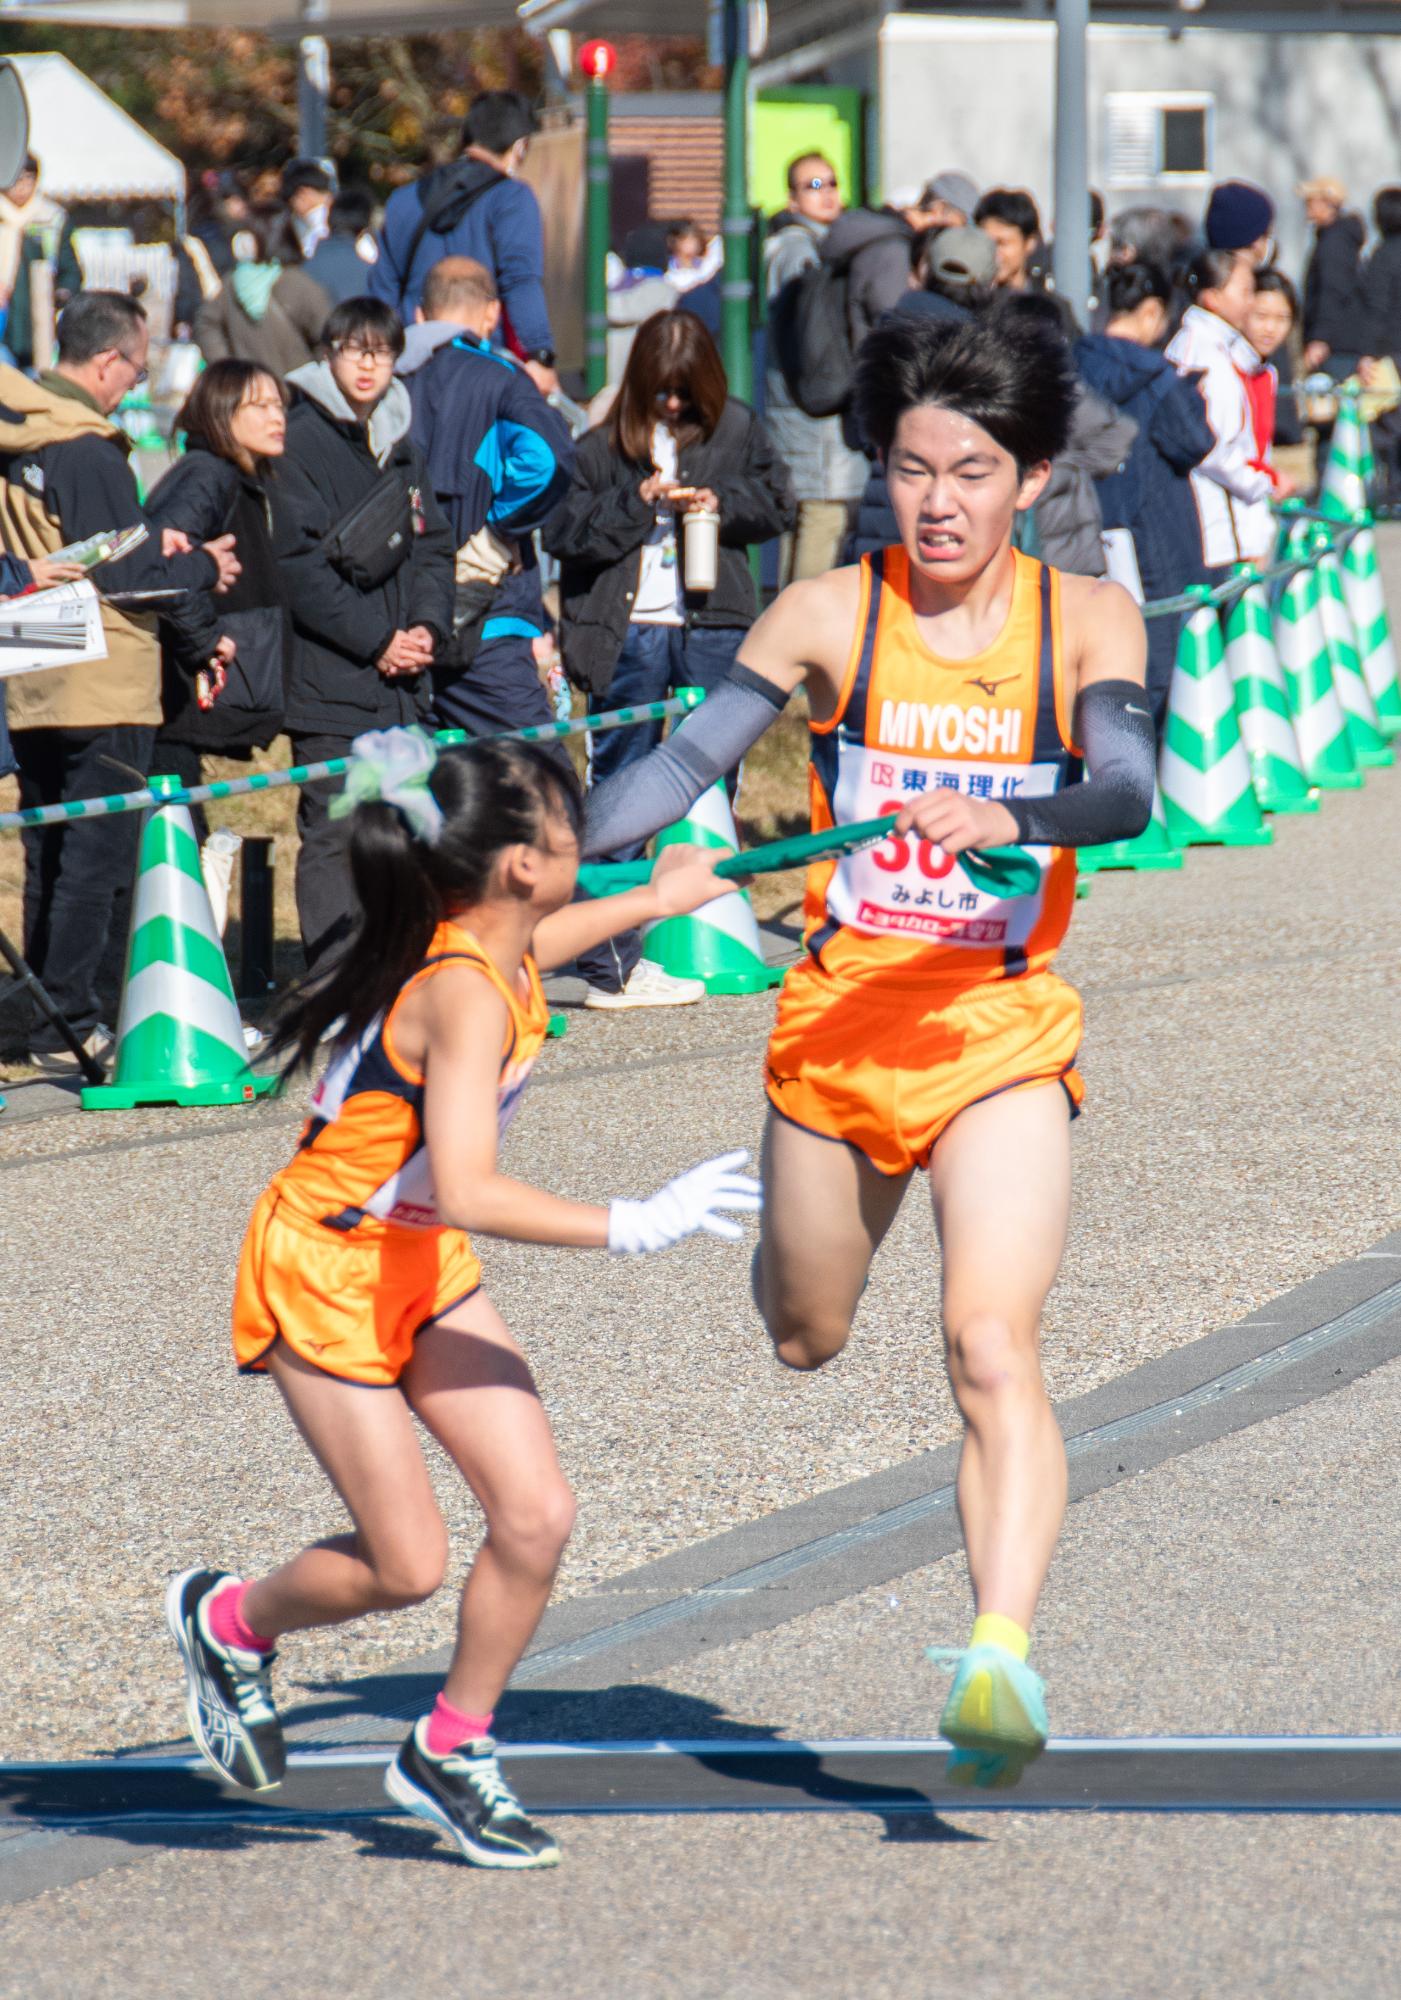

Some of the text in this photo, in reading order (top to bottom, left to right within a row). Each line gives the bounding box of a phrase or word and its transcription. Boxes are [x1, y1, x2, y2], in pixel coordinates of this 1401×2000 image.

[879, 700, 1022, 755] MIYOSHI
[891, 883, 979, 911] みよし市
